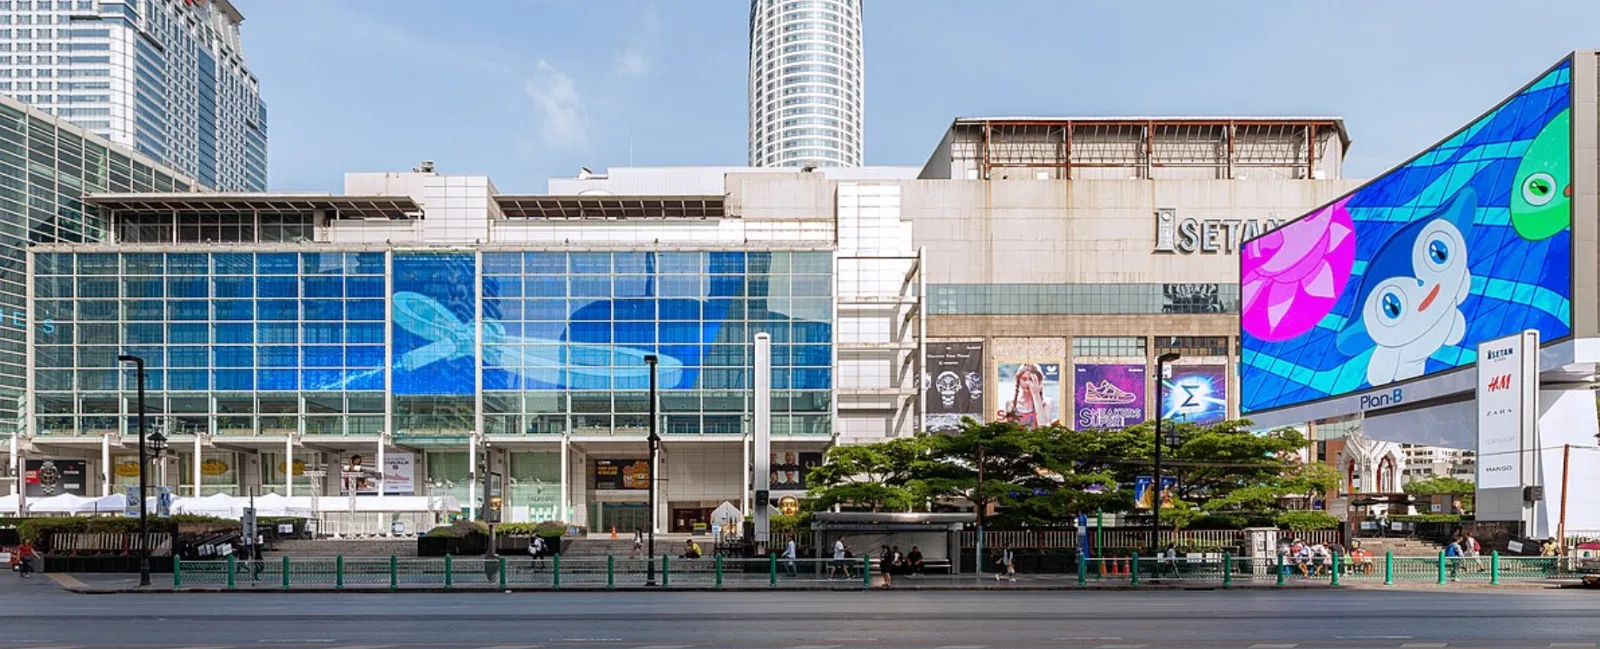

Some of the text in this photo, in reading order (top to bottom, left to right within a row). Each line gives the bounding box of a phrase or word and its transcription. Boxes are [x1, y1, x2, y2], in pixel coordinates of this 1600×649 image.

[1487, 347, 1513, 360] ISETAN
[1488, 374, 1512, 392] H&M
[1487, 408, 1512, 416] ZARA
